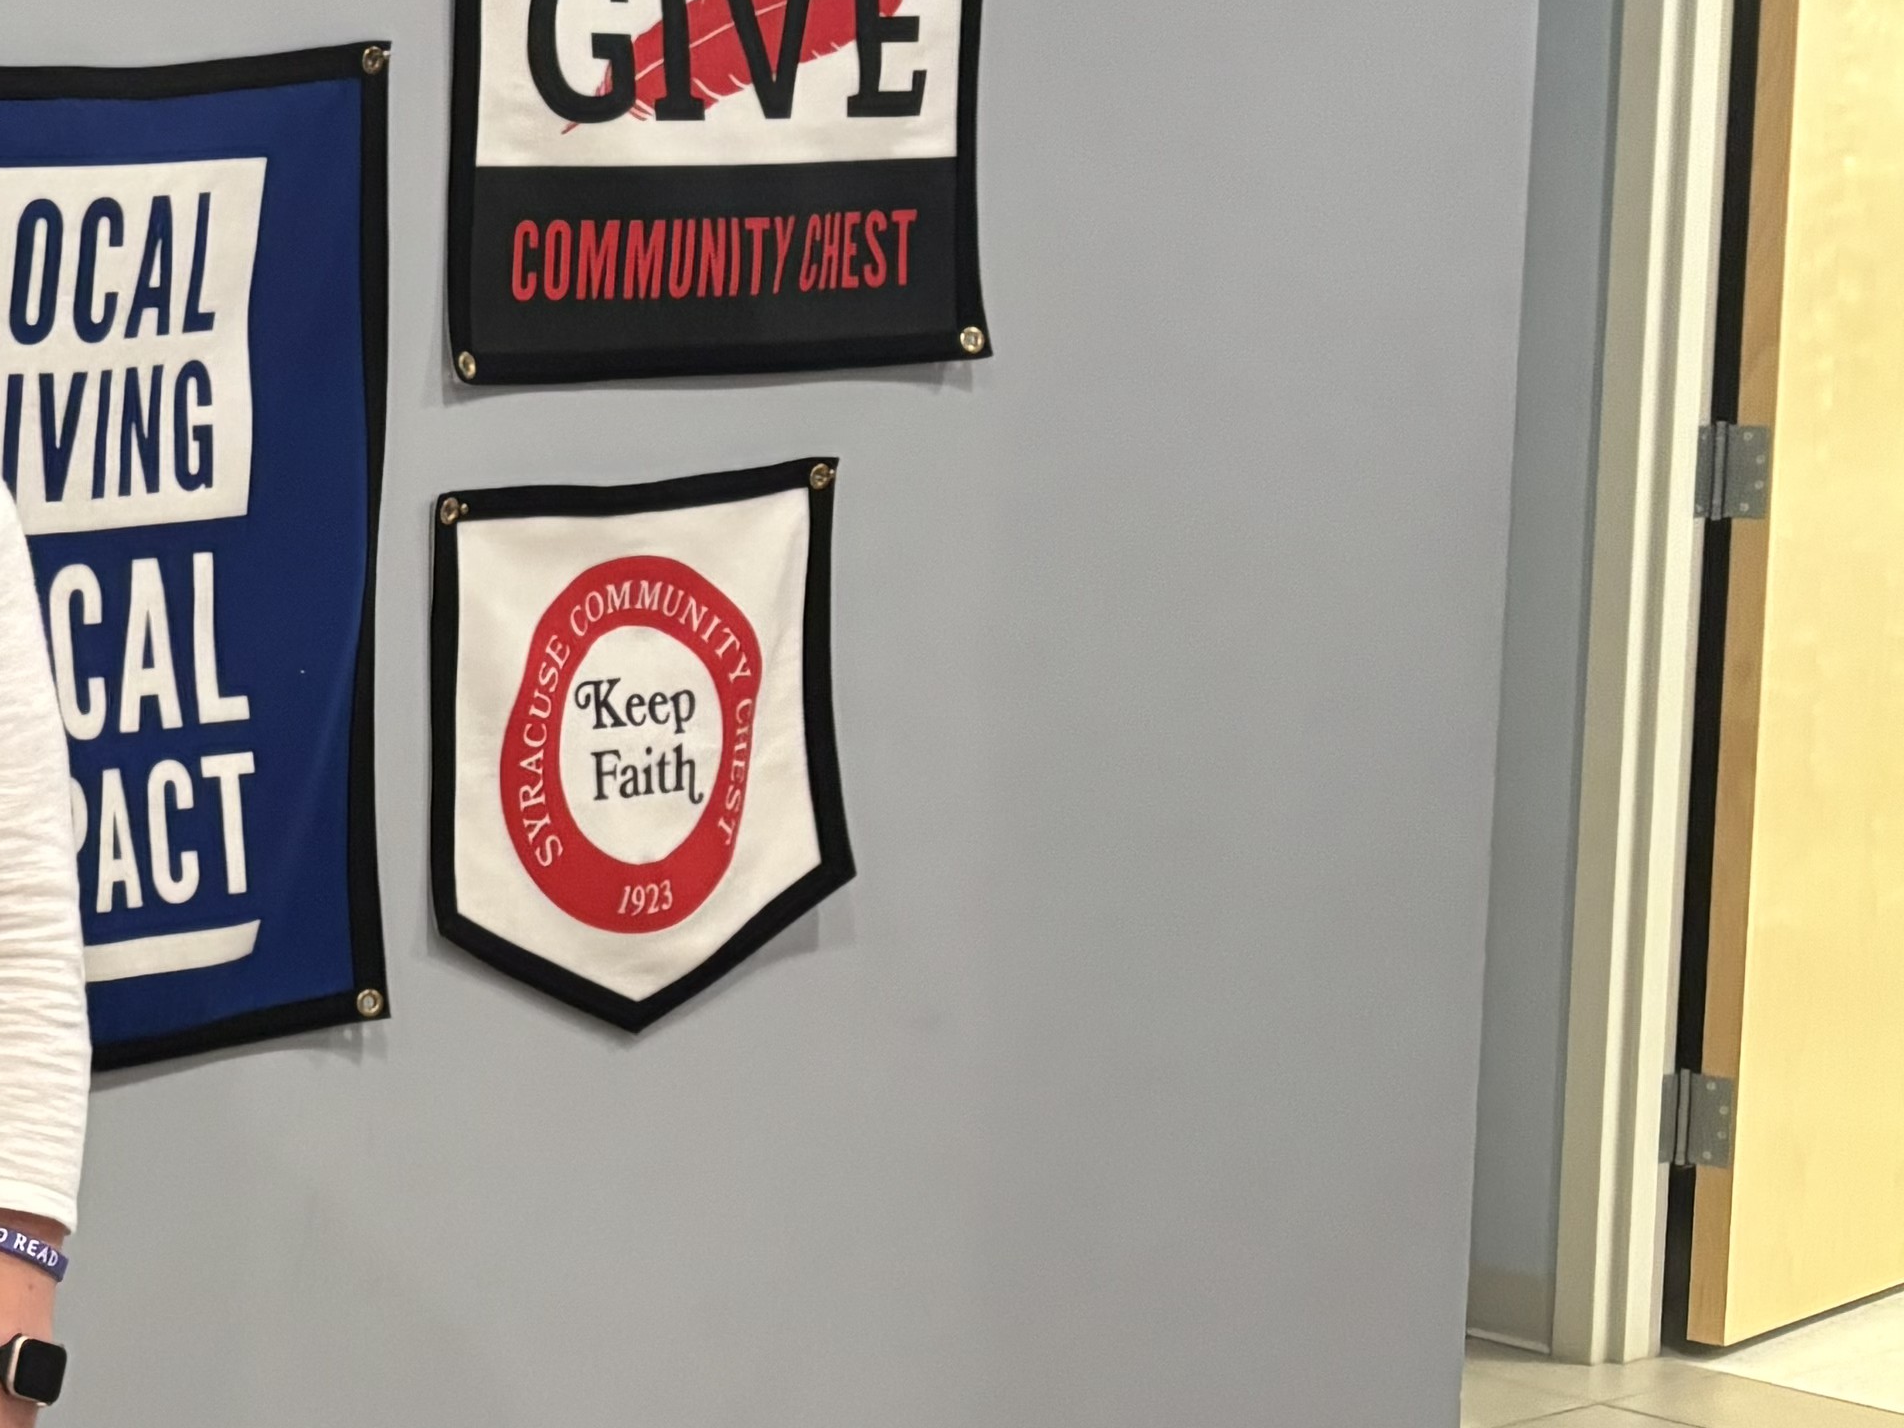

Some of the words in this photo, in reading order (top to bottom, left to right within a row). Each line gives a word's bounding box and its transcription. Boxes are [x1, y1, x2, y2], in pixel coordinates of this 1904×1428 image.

[511, 215, 795, 302] COMMUNITY
[798, 209, 918, 293] CHEST
[49, 552, 251, 741] CAL
[519, 634, 571, 868] SYRACUSE
[569, 579, 752, 685] COMMUNITY
[717, 696, 754, 847] CHEST
[574, 676, 696, 734] Keep
[590, 742, 704, 805] Faith
[618, 878, 674, 916] 1923
[13, 1232, 59, 1267] READ
